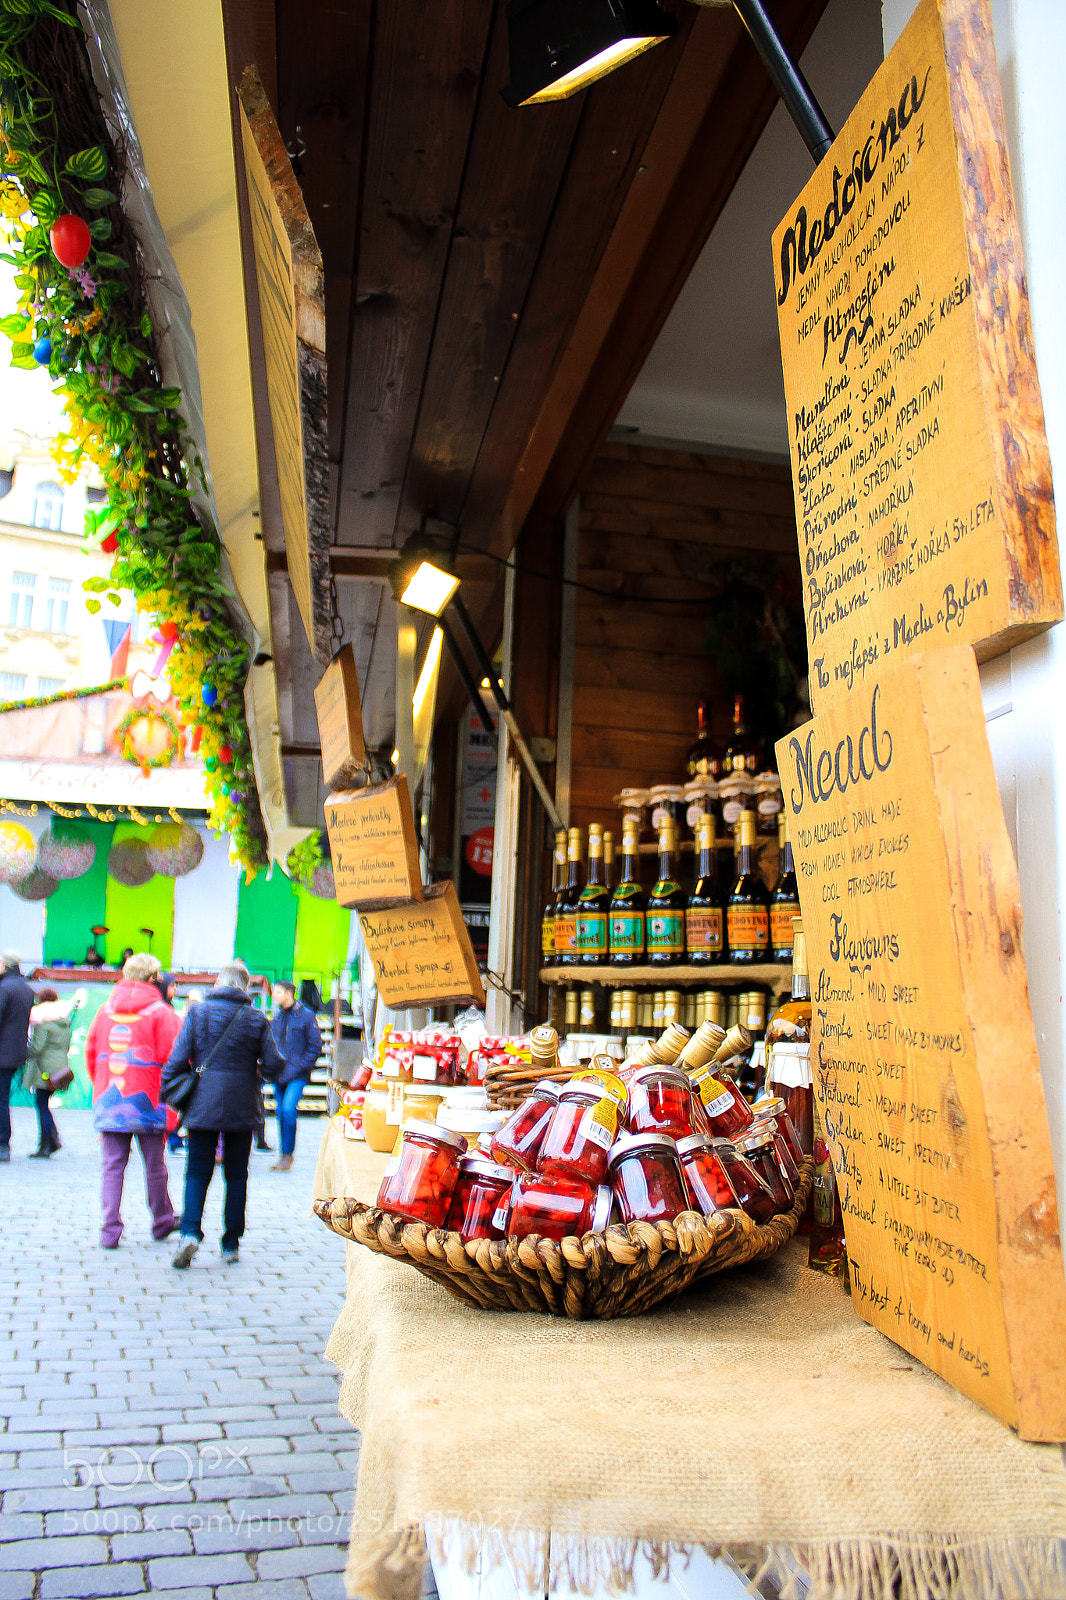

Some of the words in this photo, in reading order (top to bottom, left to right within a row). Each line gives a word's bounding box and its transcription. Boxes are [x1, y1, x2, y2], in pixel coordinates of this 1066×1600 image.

[777, 65, 931, 306] Medovina
[813, 653, 830, 689] To
[788, 683, 893, 815] Mead
[800, 858, 819, 878] FROM
[822, 883, 840, 902] COOL
[815, 968, 855, 1003] Almond
[868, 980, 887, 1003] MILD
[876, 1058, 906, 1080] SWEET
